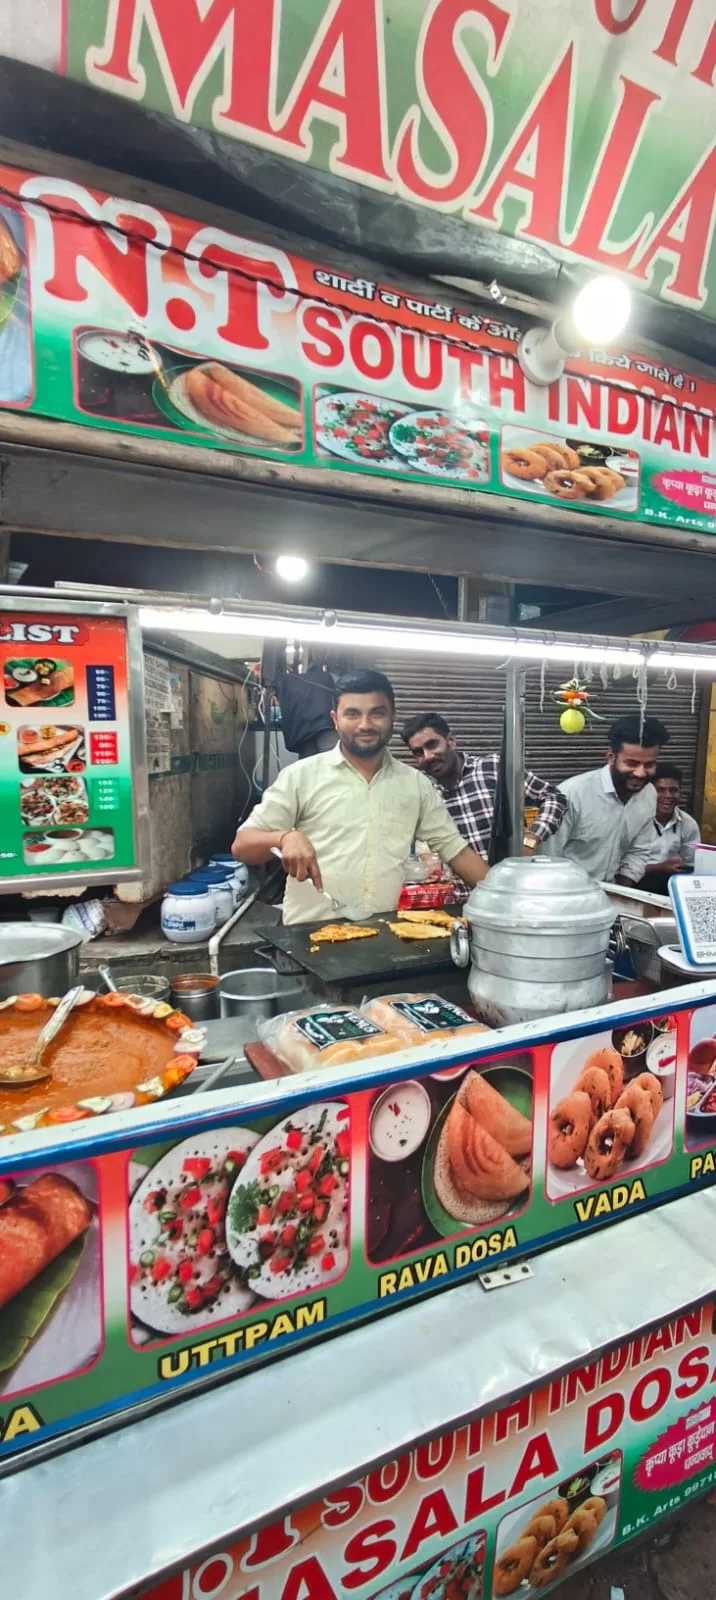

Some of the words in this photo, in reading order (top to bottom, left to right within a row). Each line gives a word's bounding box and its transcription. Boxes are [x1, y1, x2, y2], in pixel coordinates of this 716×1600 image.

[92, 0, 716, 301] MASALA
[30, 195, 290, 352] N.T
[381, 290, 400, 308] व
[301, 305, 526, 415] SOUTH
[543, 372, 713, 458] INDIAN
[675, 515, 704, 527] Arts
[575, 1180, 646, 1222] VADA
[379, 1254, 449, 1298] RAVA
[455, 1229, 518, 1269] DOSA
[160, 1301, 325, 1379] UTTPAM
[0, 1406, 42, 1441] A
[321, 1394, 529, 1526] SOUTH
[549, 1305, 703, 1414] INDIAN
[238, 1432, 560, 1600] ASALA
[583, 1345, 716, 1455] DOS
[622, 1514, 650, 1537] B.K.
[653, 1496, 681, 1517] Arts
